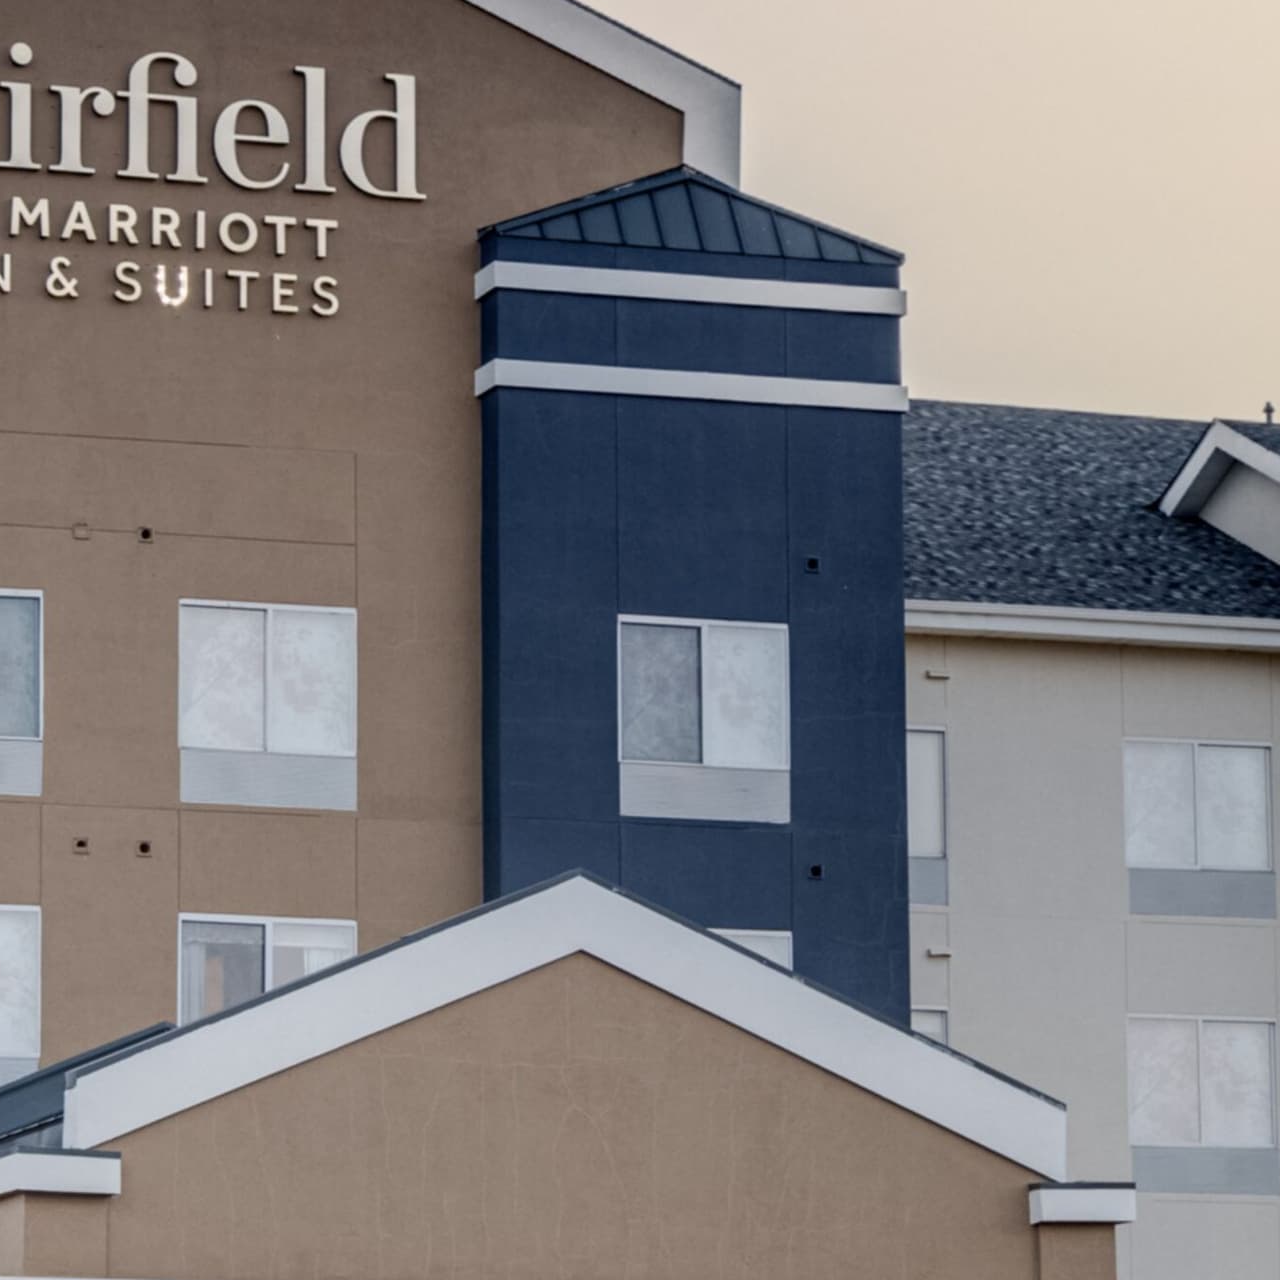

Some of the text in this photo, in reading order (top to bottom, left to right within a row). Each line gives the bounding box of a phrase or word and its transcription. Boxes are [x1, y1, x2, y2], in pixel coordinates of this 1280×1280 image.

[10, 197, 339, 258] MARRIOTT
[46, 257, 79, 298] &
[114, 262, 340, 317] SUITES
